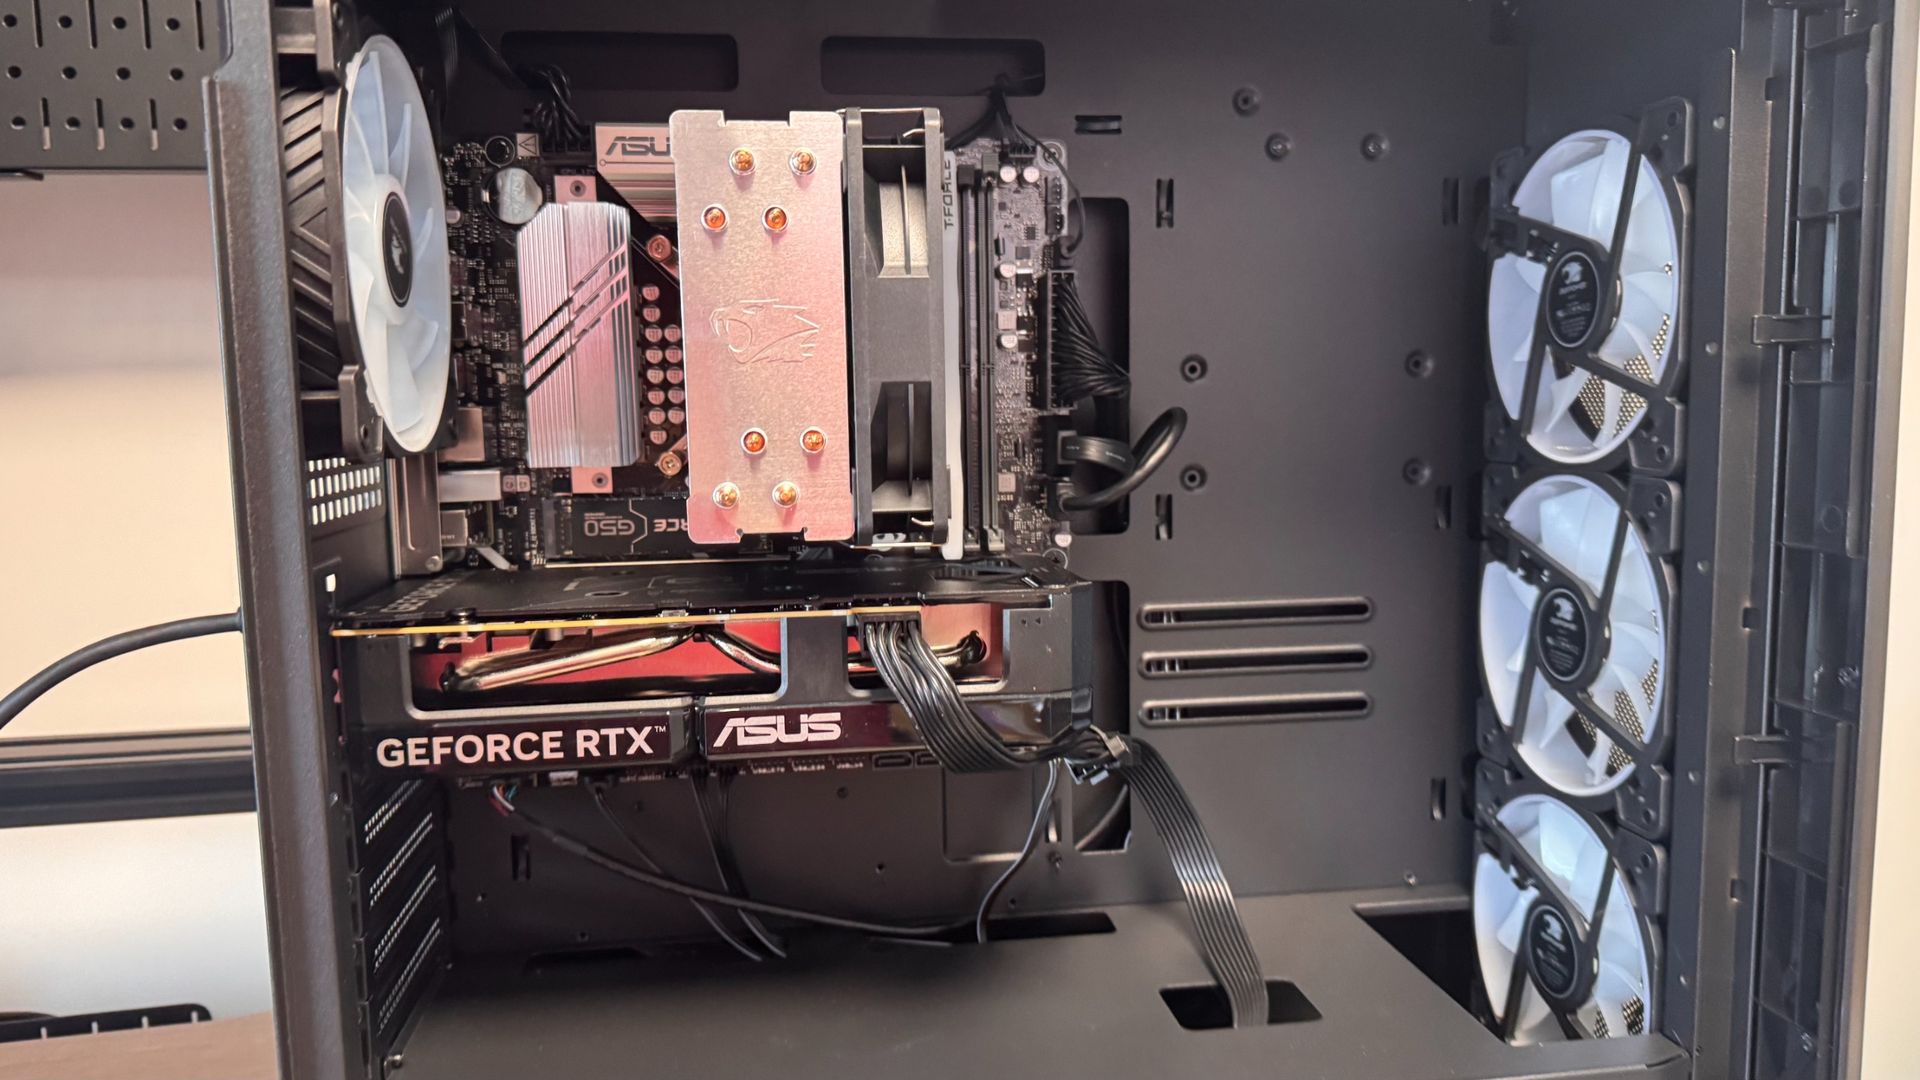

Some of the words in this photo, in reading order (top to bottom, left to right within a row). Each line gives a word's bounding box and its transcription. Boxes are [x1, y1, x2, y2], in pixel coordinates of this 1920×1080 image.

[606, 136, 671, 156] ASU
[583, 519, 636, 537] G50
[712, 712, 842, 748] ASUS
[376, 731, 564, 768] GEFORCE
